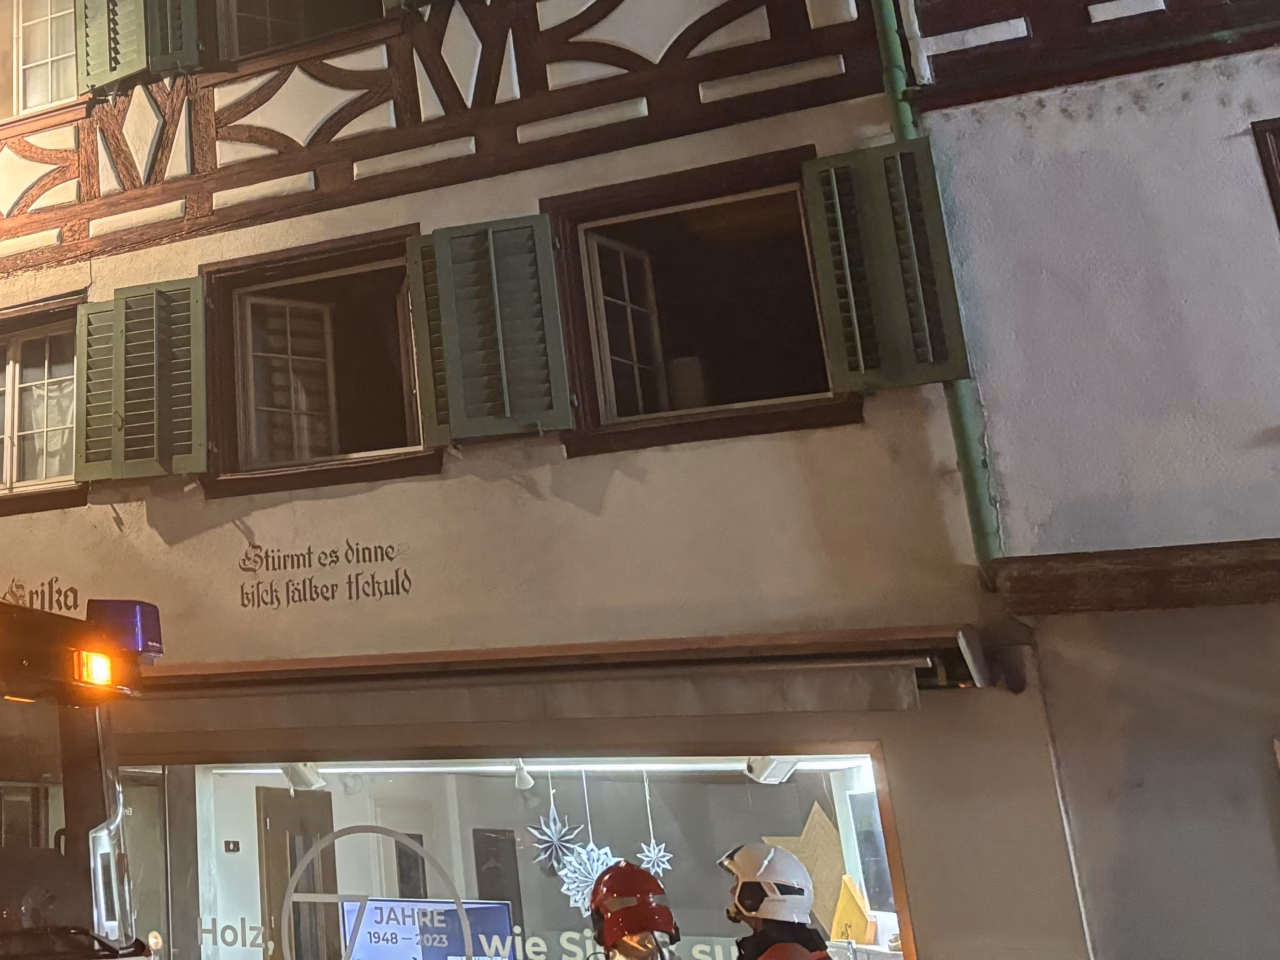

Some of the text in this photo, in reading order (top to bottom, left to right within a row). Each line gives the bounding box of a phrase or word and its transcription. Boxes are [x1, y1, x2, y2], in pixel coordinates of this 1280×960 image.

[238, 538, 400, 573] Stürmt es dinne
[7, 576, 80, 612] Erika
[286, 575, 339, 608] sälber
[373, 906, 447, 928] JAHRE
[197, 916, 275, 955] Holz,
[367, 931, 399, 945] 1948
[415, 933, 449, 947] 2023
[477, 925, 548, 960] wie
